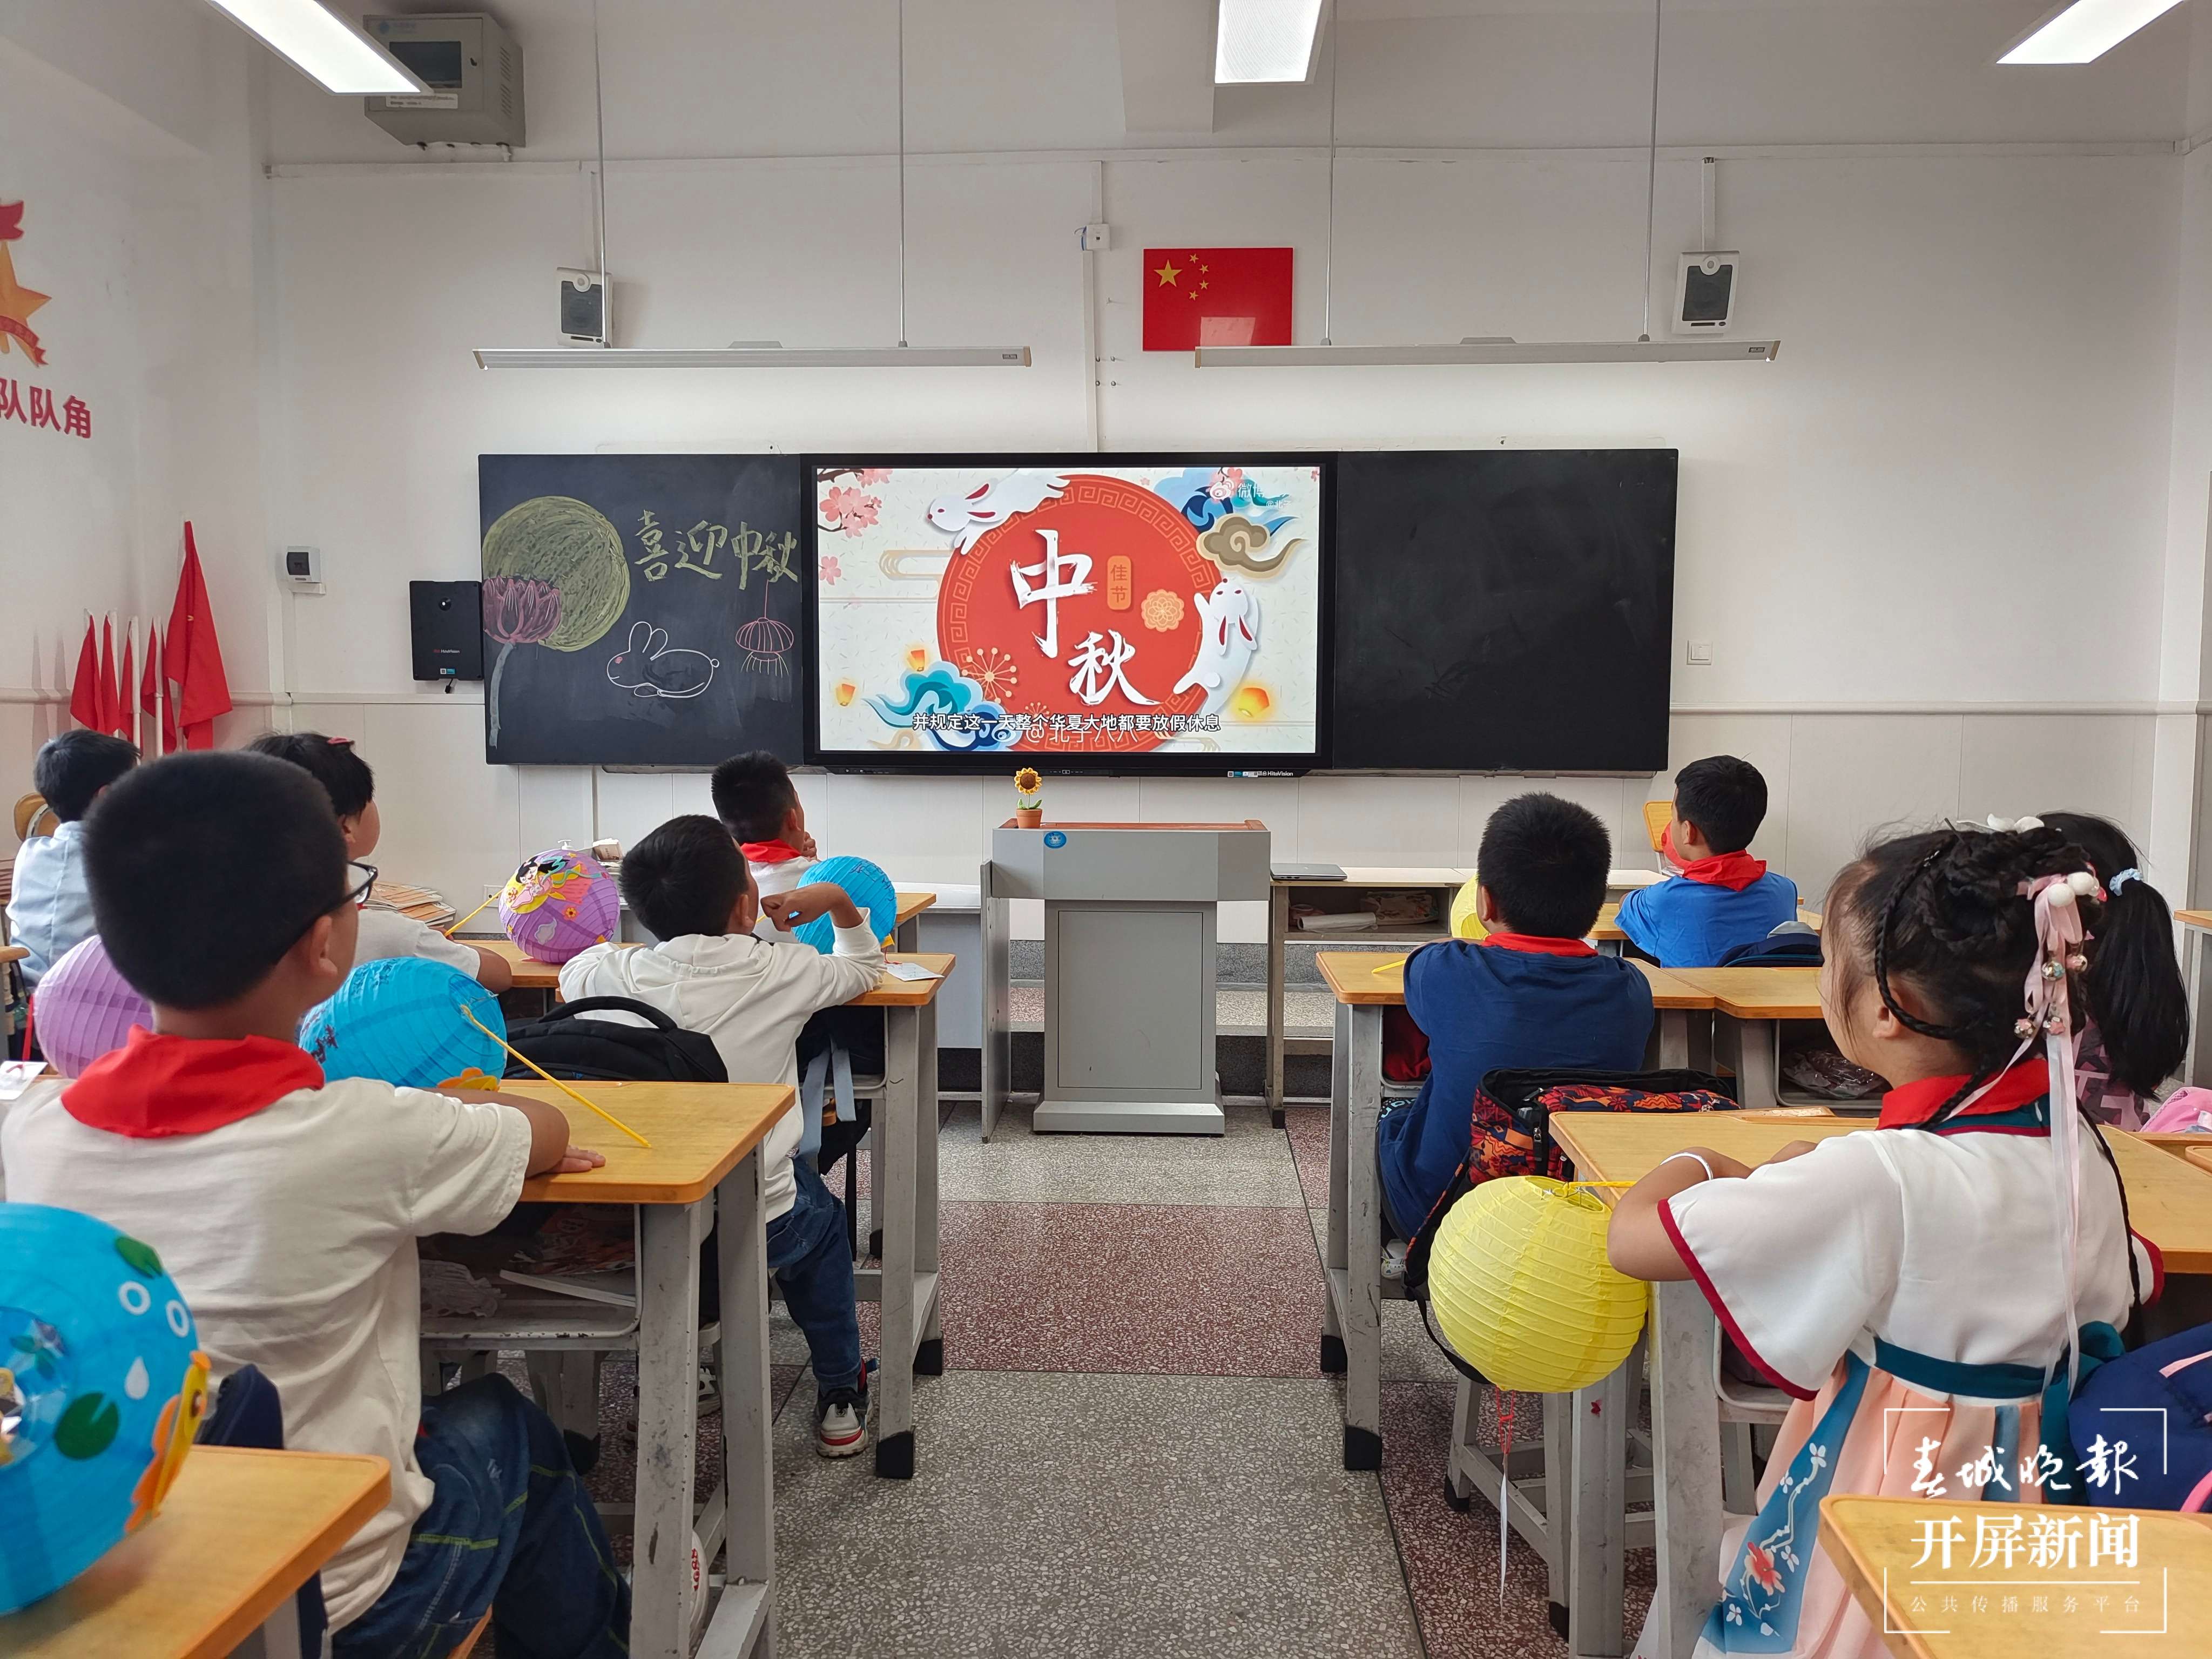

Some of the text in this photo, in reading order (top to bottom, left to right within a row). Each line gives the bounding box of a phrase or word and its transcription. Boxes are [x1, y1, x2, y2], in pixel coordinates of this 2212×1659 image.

[0, 376, 91, 439] 队队角
[633, 509, 798, 590] 喜迎中秋
[1110, 564, 1128, 603] 佳节
[912, 713, 1222, 732] 并规定这一天整个华夏大地都要放假休息
